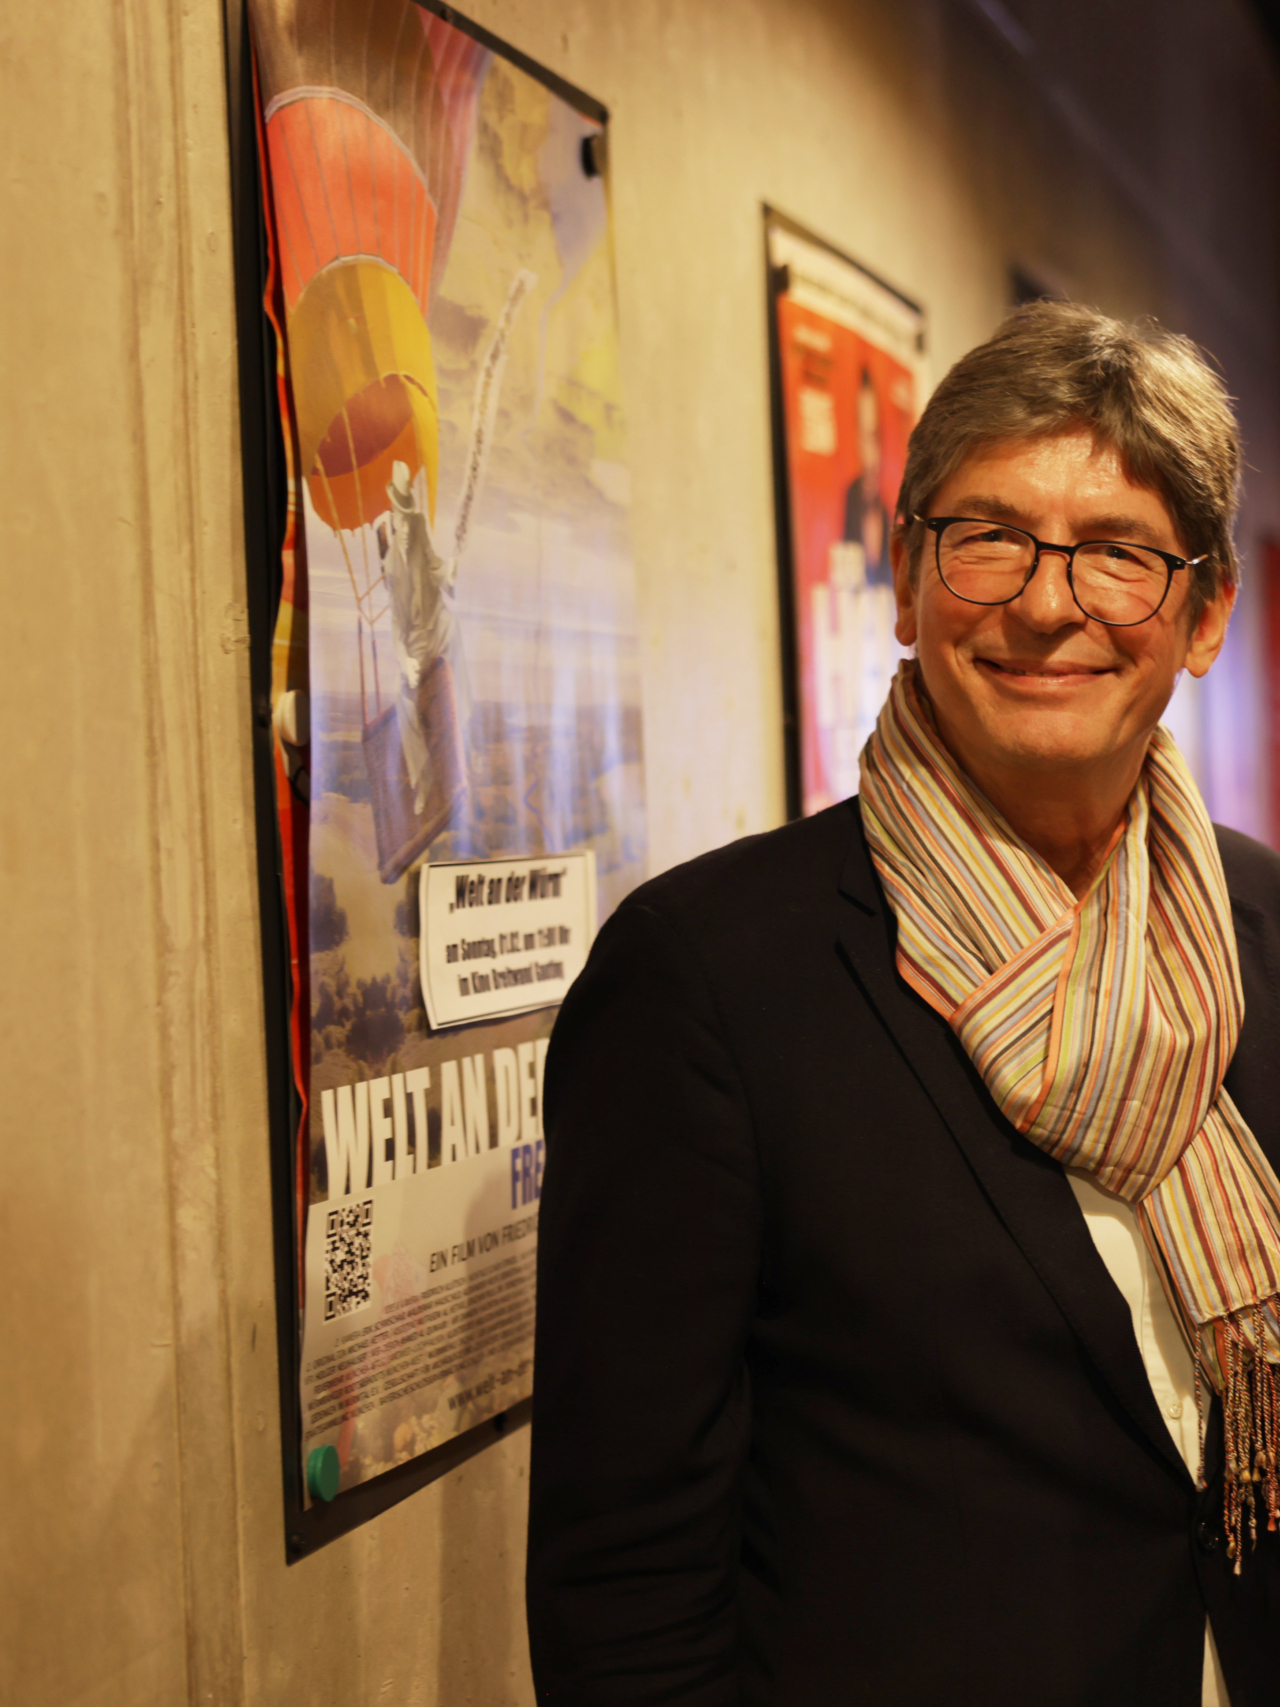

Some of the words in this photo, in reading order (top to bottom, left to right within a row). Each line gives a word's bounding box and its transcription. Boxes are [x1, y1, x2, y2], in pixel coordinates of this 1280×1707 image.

[487, 877, 503, 905] an
[505, 871, 527, 903] der
[321, 1066, 431, 1201] WELT
[441, 1053, 492, 1167] AN
[430, 1248, 448, 1273] EIN
[451, 1239, 475, 1265] FILM
[478, 1230, 499, 1254] VON
